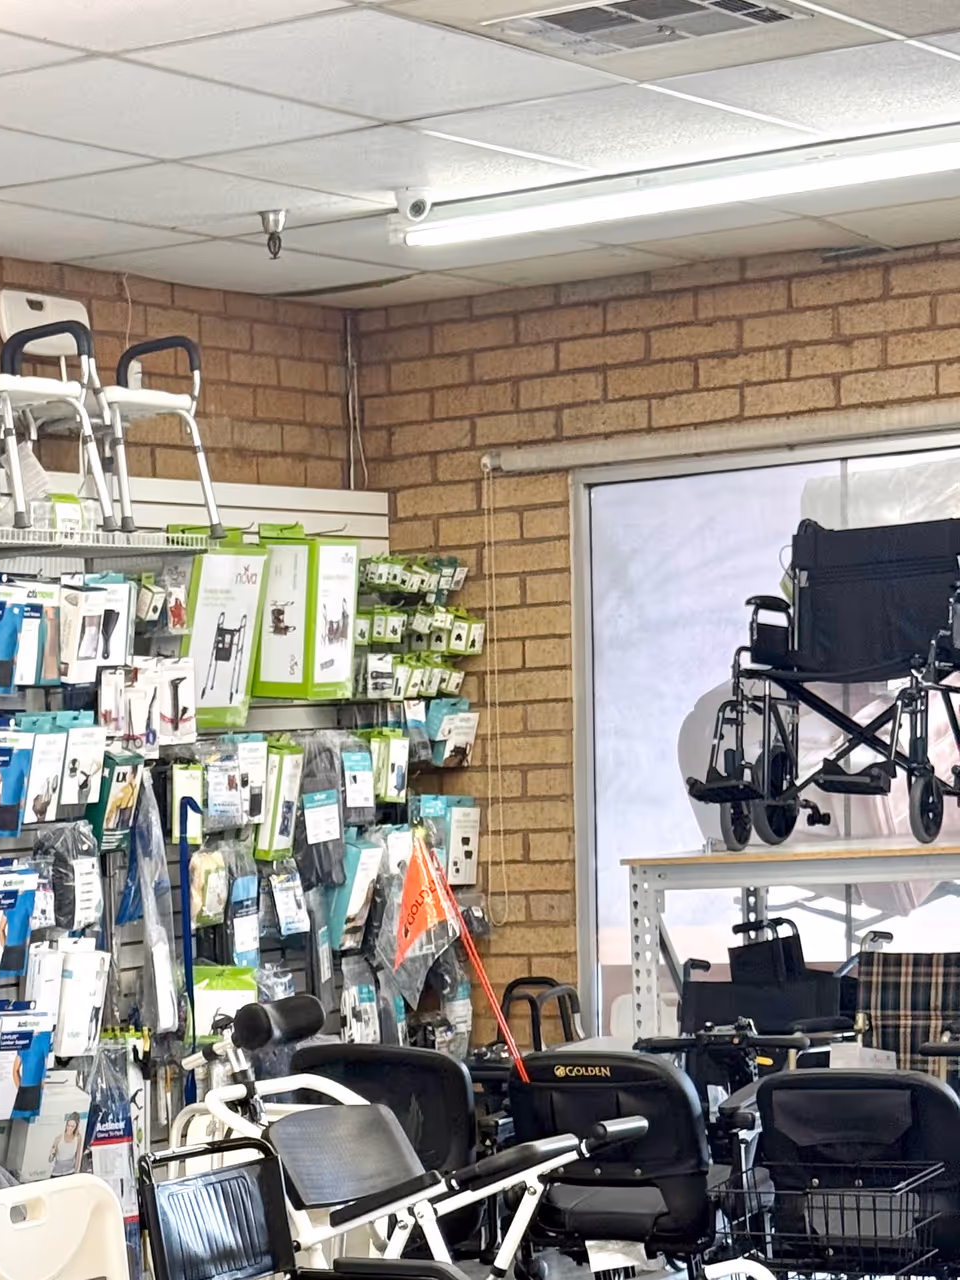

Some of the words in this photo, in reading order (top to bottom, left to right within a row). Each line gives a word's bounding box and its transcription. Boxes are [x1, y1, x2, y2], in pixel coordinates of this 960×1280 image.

[235, 572, 257, 585] nova
[407, 879, 436, 927] GOLDE
[566, 1066, 610, 1077] GOLDEN
